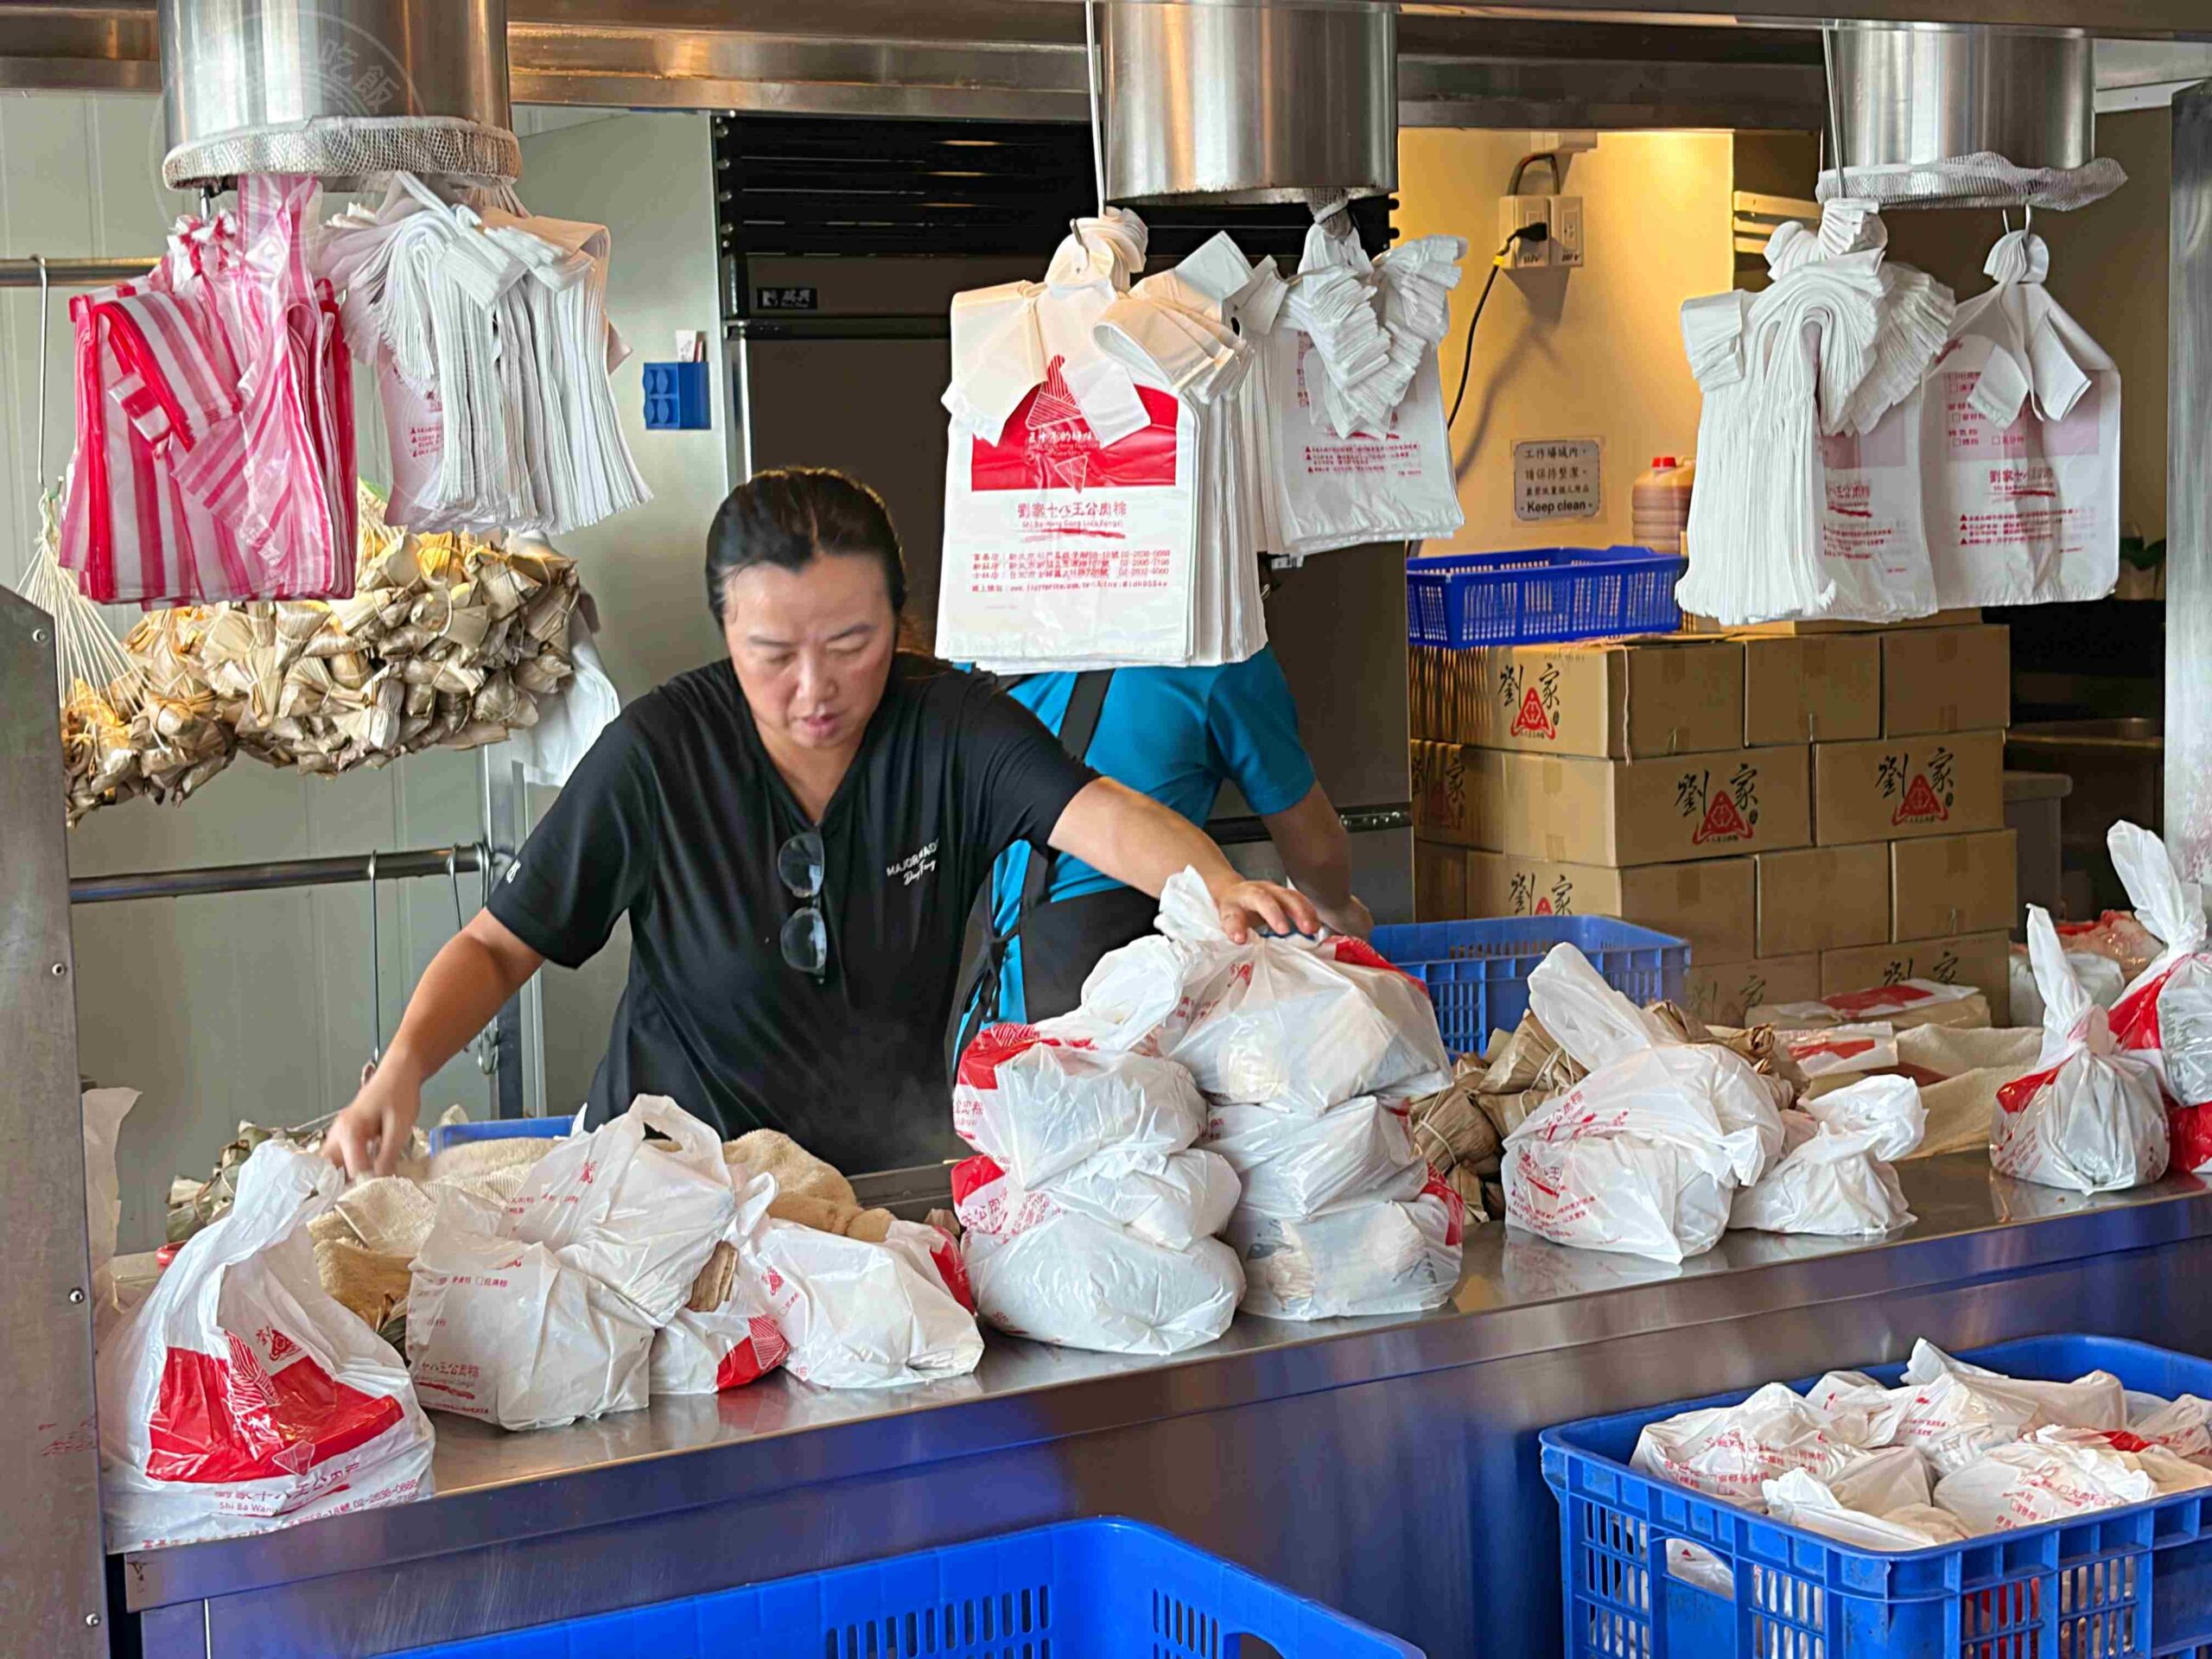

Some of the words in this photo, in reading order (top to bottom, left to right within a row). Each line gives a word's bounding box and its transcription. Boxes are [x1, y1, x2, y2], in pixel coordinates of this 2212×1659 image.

[1527, 500, 1555, 514] Keep
[1557, 500, 1586, 512] clean
[1497, 663, 1560, 709] 劉家
[1674, 763, 1758, 817] 劉家
[1874, 747, 1955, 798] 劉家
[219, 1502, 234, 1510] Shi
[237, 1503, 249, 1511] Ba
